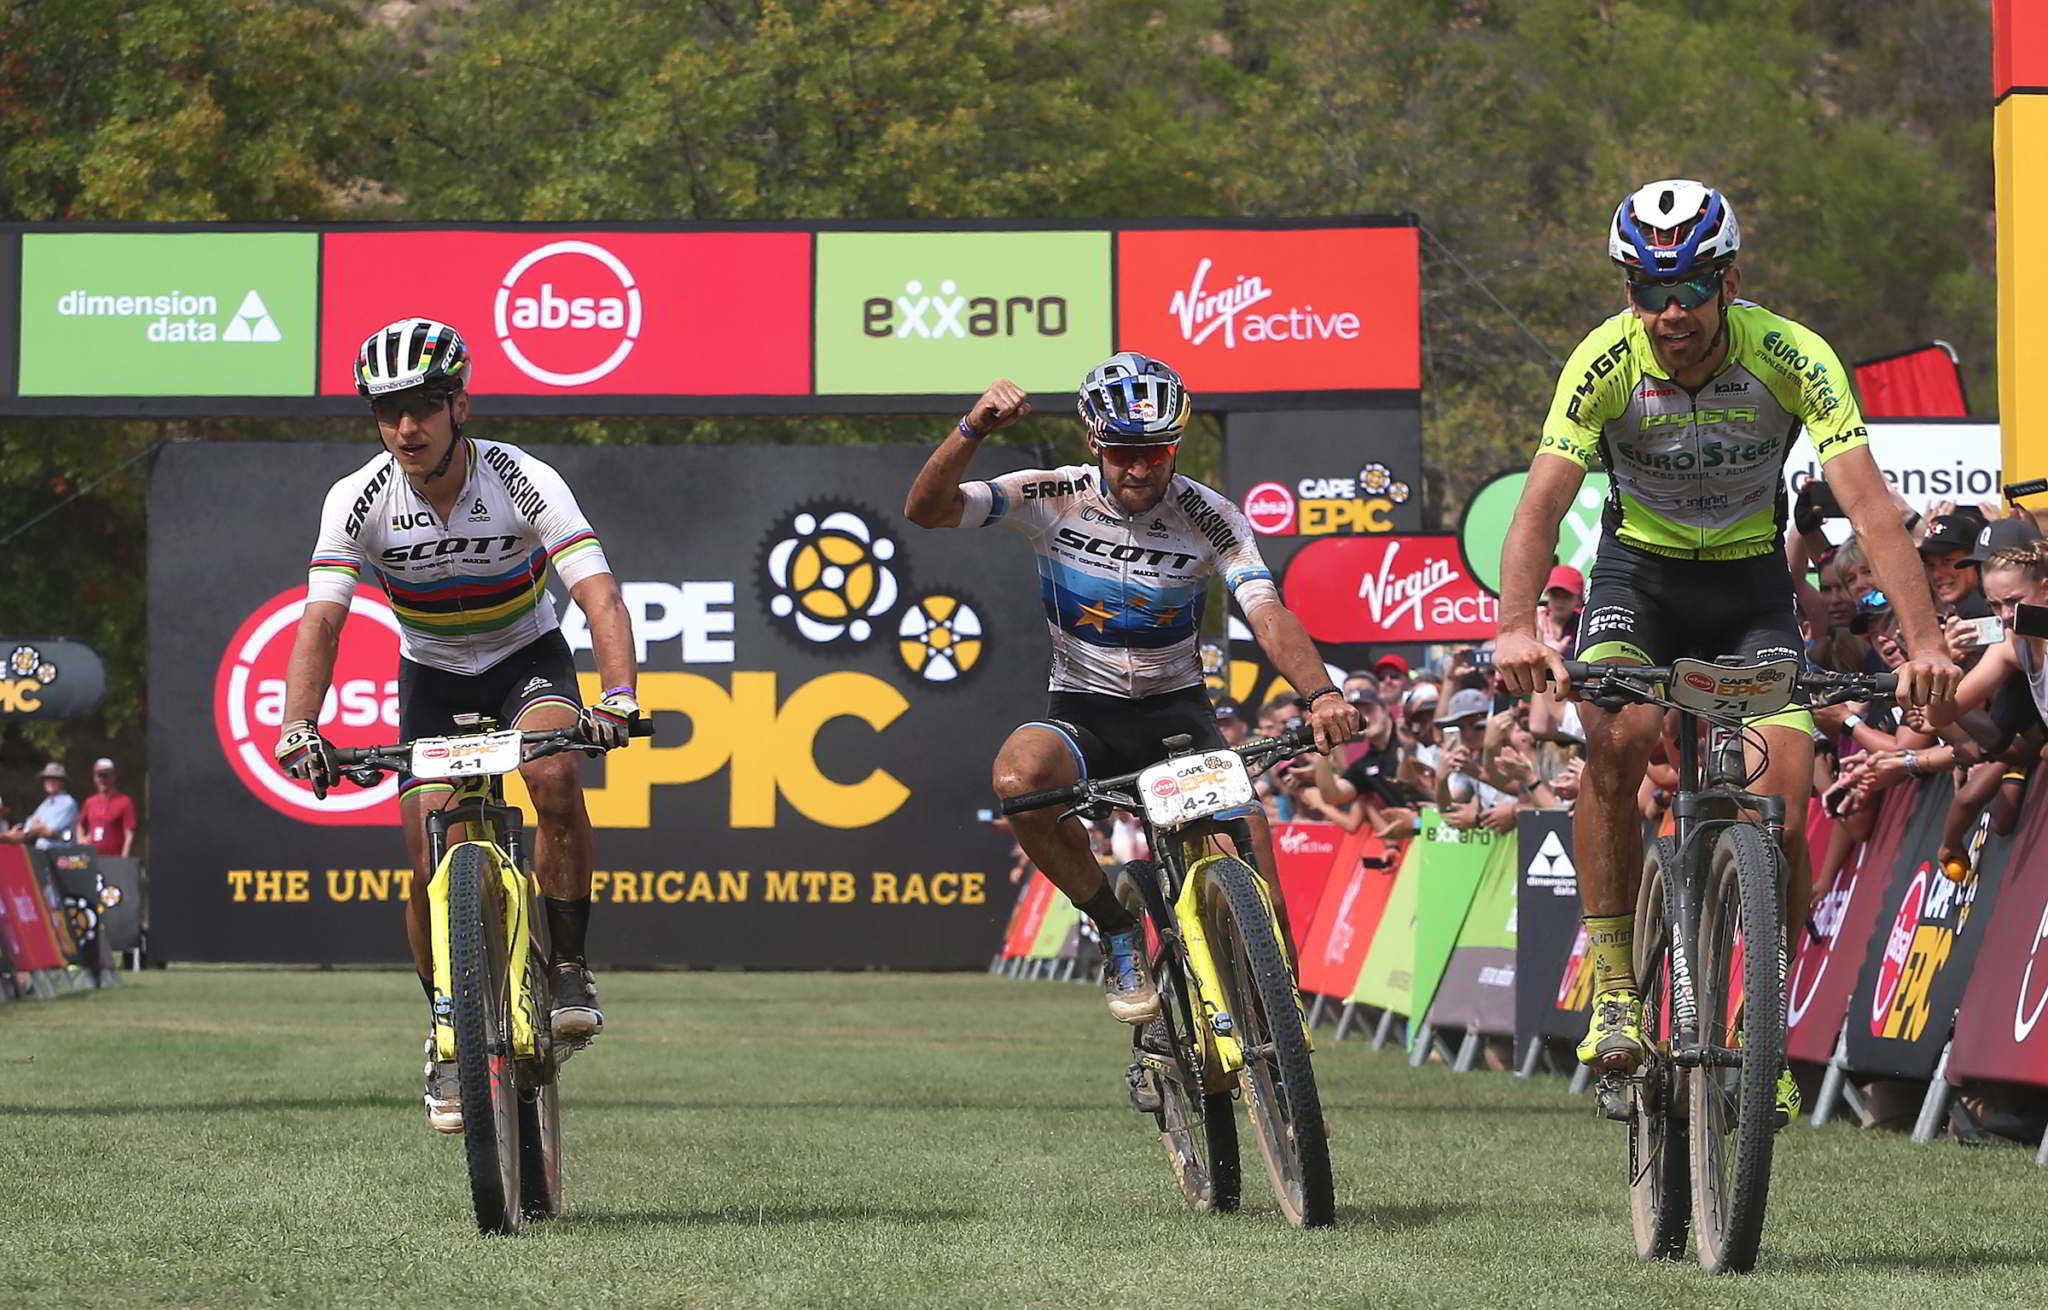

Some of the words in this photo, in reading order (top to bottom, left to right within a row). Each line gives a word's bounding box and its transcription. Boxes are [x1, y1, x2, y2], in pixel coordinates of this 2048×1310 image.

[1654, 251, 1678, 259] uvex
[58, 290, 217, 316] dimension
[511, 283, 624, 329] absa
[863, 280, 1067, 337] exxaro
[1169, 257, 1272, 348] Virgin
[147, 317, 217, 342] data
[1242, 305, 1360, 341] active
[1763, 331, 1809, 371] EURO
[1640, 407, 1760, 432] PYGA
[1819, 426, 1868, 454] PYG
[483, 445, 548, 526] ROCKSHOX
[1298, 478, 1356, 499] CAPE
[400, 511, 436, 530] UCI
[1177, 486, 1239, 556] ROCKSHOX
[1299, 498, 1394, 535] EPIC
[380, 535, 524, 563] SCOTT
[1054, 528, 1198, 570] SCOTT
[1979, 526, 1992, 547] Q
[1358, 541, 1460, 631] Virgin
[1431, 589, 1499, 624] acti
[562, 581, 735, 664] PE
[1715, 682, 1774, 697] EPIC
[1719, 677, 1755, 686] CAPE
[1713, 699, 1749, 712] 7-1
[449, 758, 482, 770] 4-1
[1176, 765, 1205, 778] CAPE
[1183, 791, 1220, 810] 4-2
[1426, 821, 1492, 846] exxaro
[227, 870, 310, 902] THE
[591, 870, 750, 902] FRICAN
[764, 871, 856, 902] MTB
[871, 871, 986, 904] RACE
